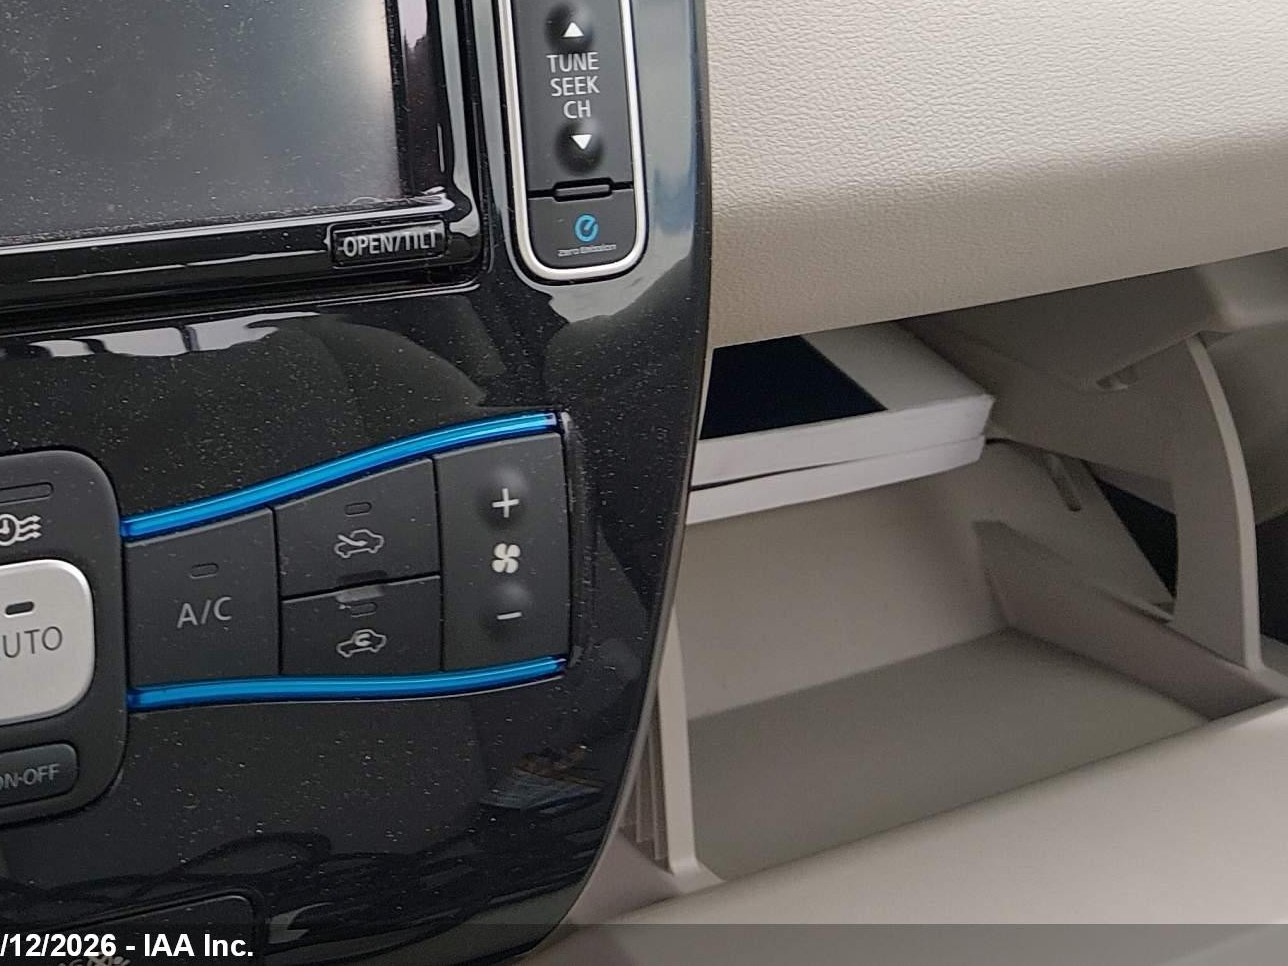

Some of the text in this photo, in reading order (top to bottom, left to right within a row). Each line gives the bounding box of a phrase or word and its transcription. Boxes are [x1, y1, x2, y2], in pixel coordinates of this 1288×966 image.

[545, 51, 601, 73] TUNE
[550, 75, 601, 97] SEEK
[563, 99, 592, 119] CH
[343, 230, 438, 257] OPEN/TILT
[176, 596, 233, 629] A/C
